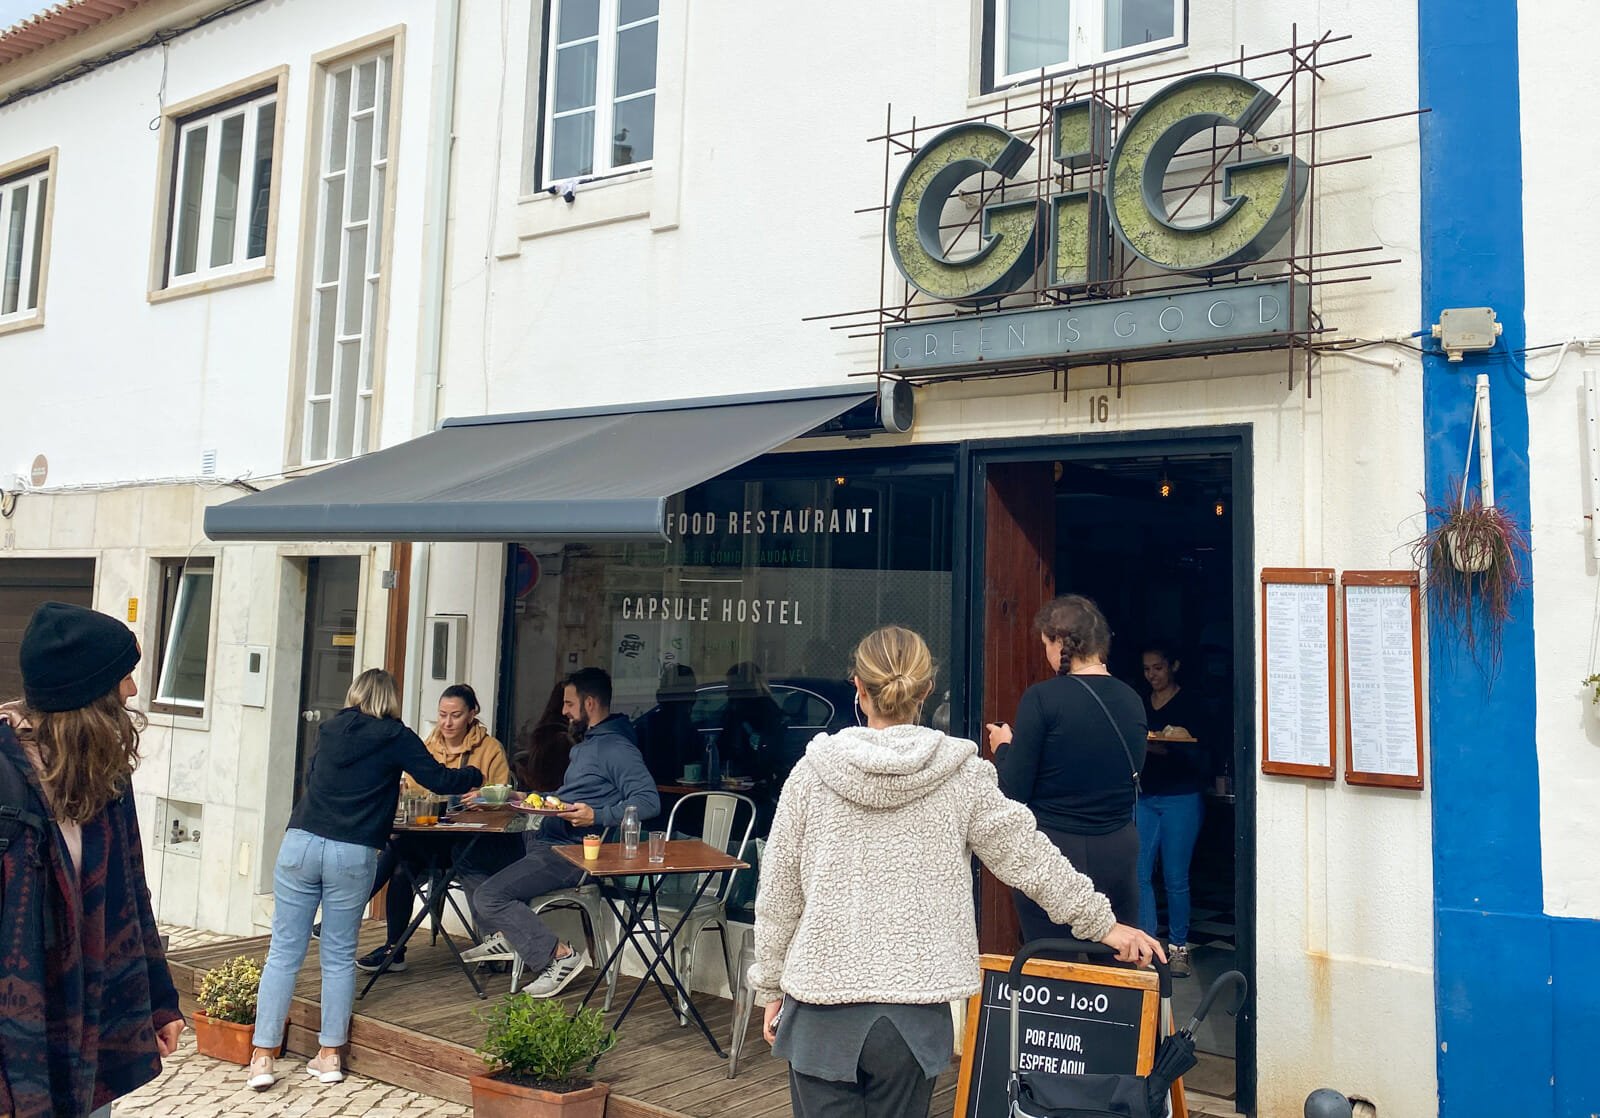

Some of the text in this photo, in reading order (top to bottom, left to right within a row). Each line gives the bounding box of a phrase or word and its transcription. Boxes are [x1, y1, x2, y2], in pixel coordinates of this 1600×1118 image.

[893, 294, 1281, 361] GREEN IS GOOD
[1089, 395, 1109, 423] 16
[666, 508, 873, 535] FOOD RESTAURANT
[622, 597, 802, 625] CAPSULE HOSTEL
[1025, 1028, 1084, 1055] POR FAVOR,
